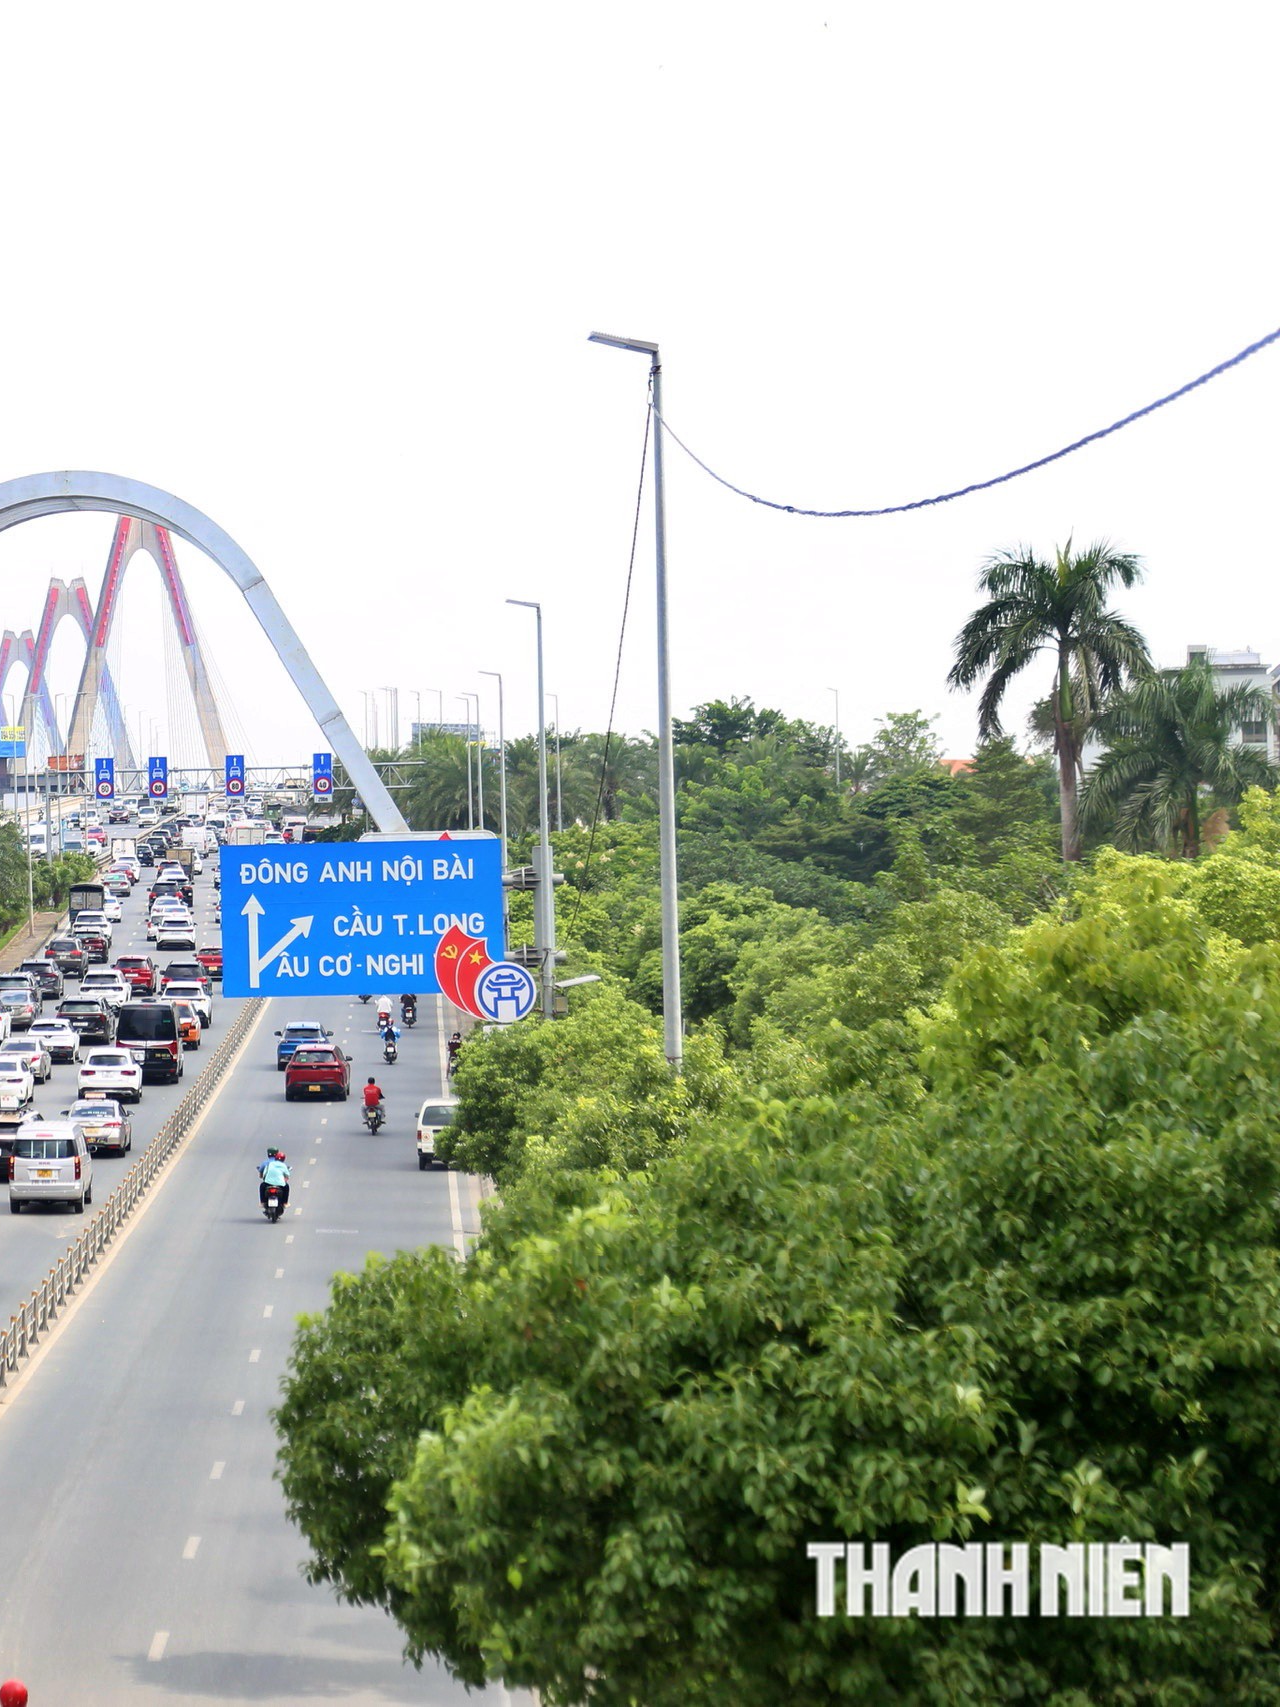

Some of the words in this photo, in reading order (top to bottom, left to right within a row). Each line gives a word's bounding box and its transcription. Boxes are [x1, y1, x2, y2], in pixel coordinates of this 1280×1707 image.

[240, 857, 309, 885] ĐÔNG
[319, 860, 372, 883] ANH
[382, 855, 423, 886] NỘI
[433, 853, 474, 881] BÀI
[333, 904, 383, 937] CẦU
[276, 951, 310, 978] ÂU
